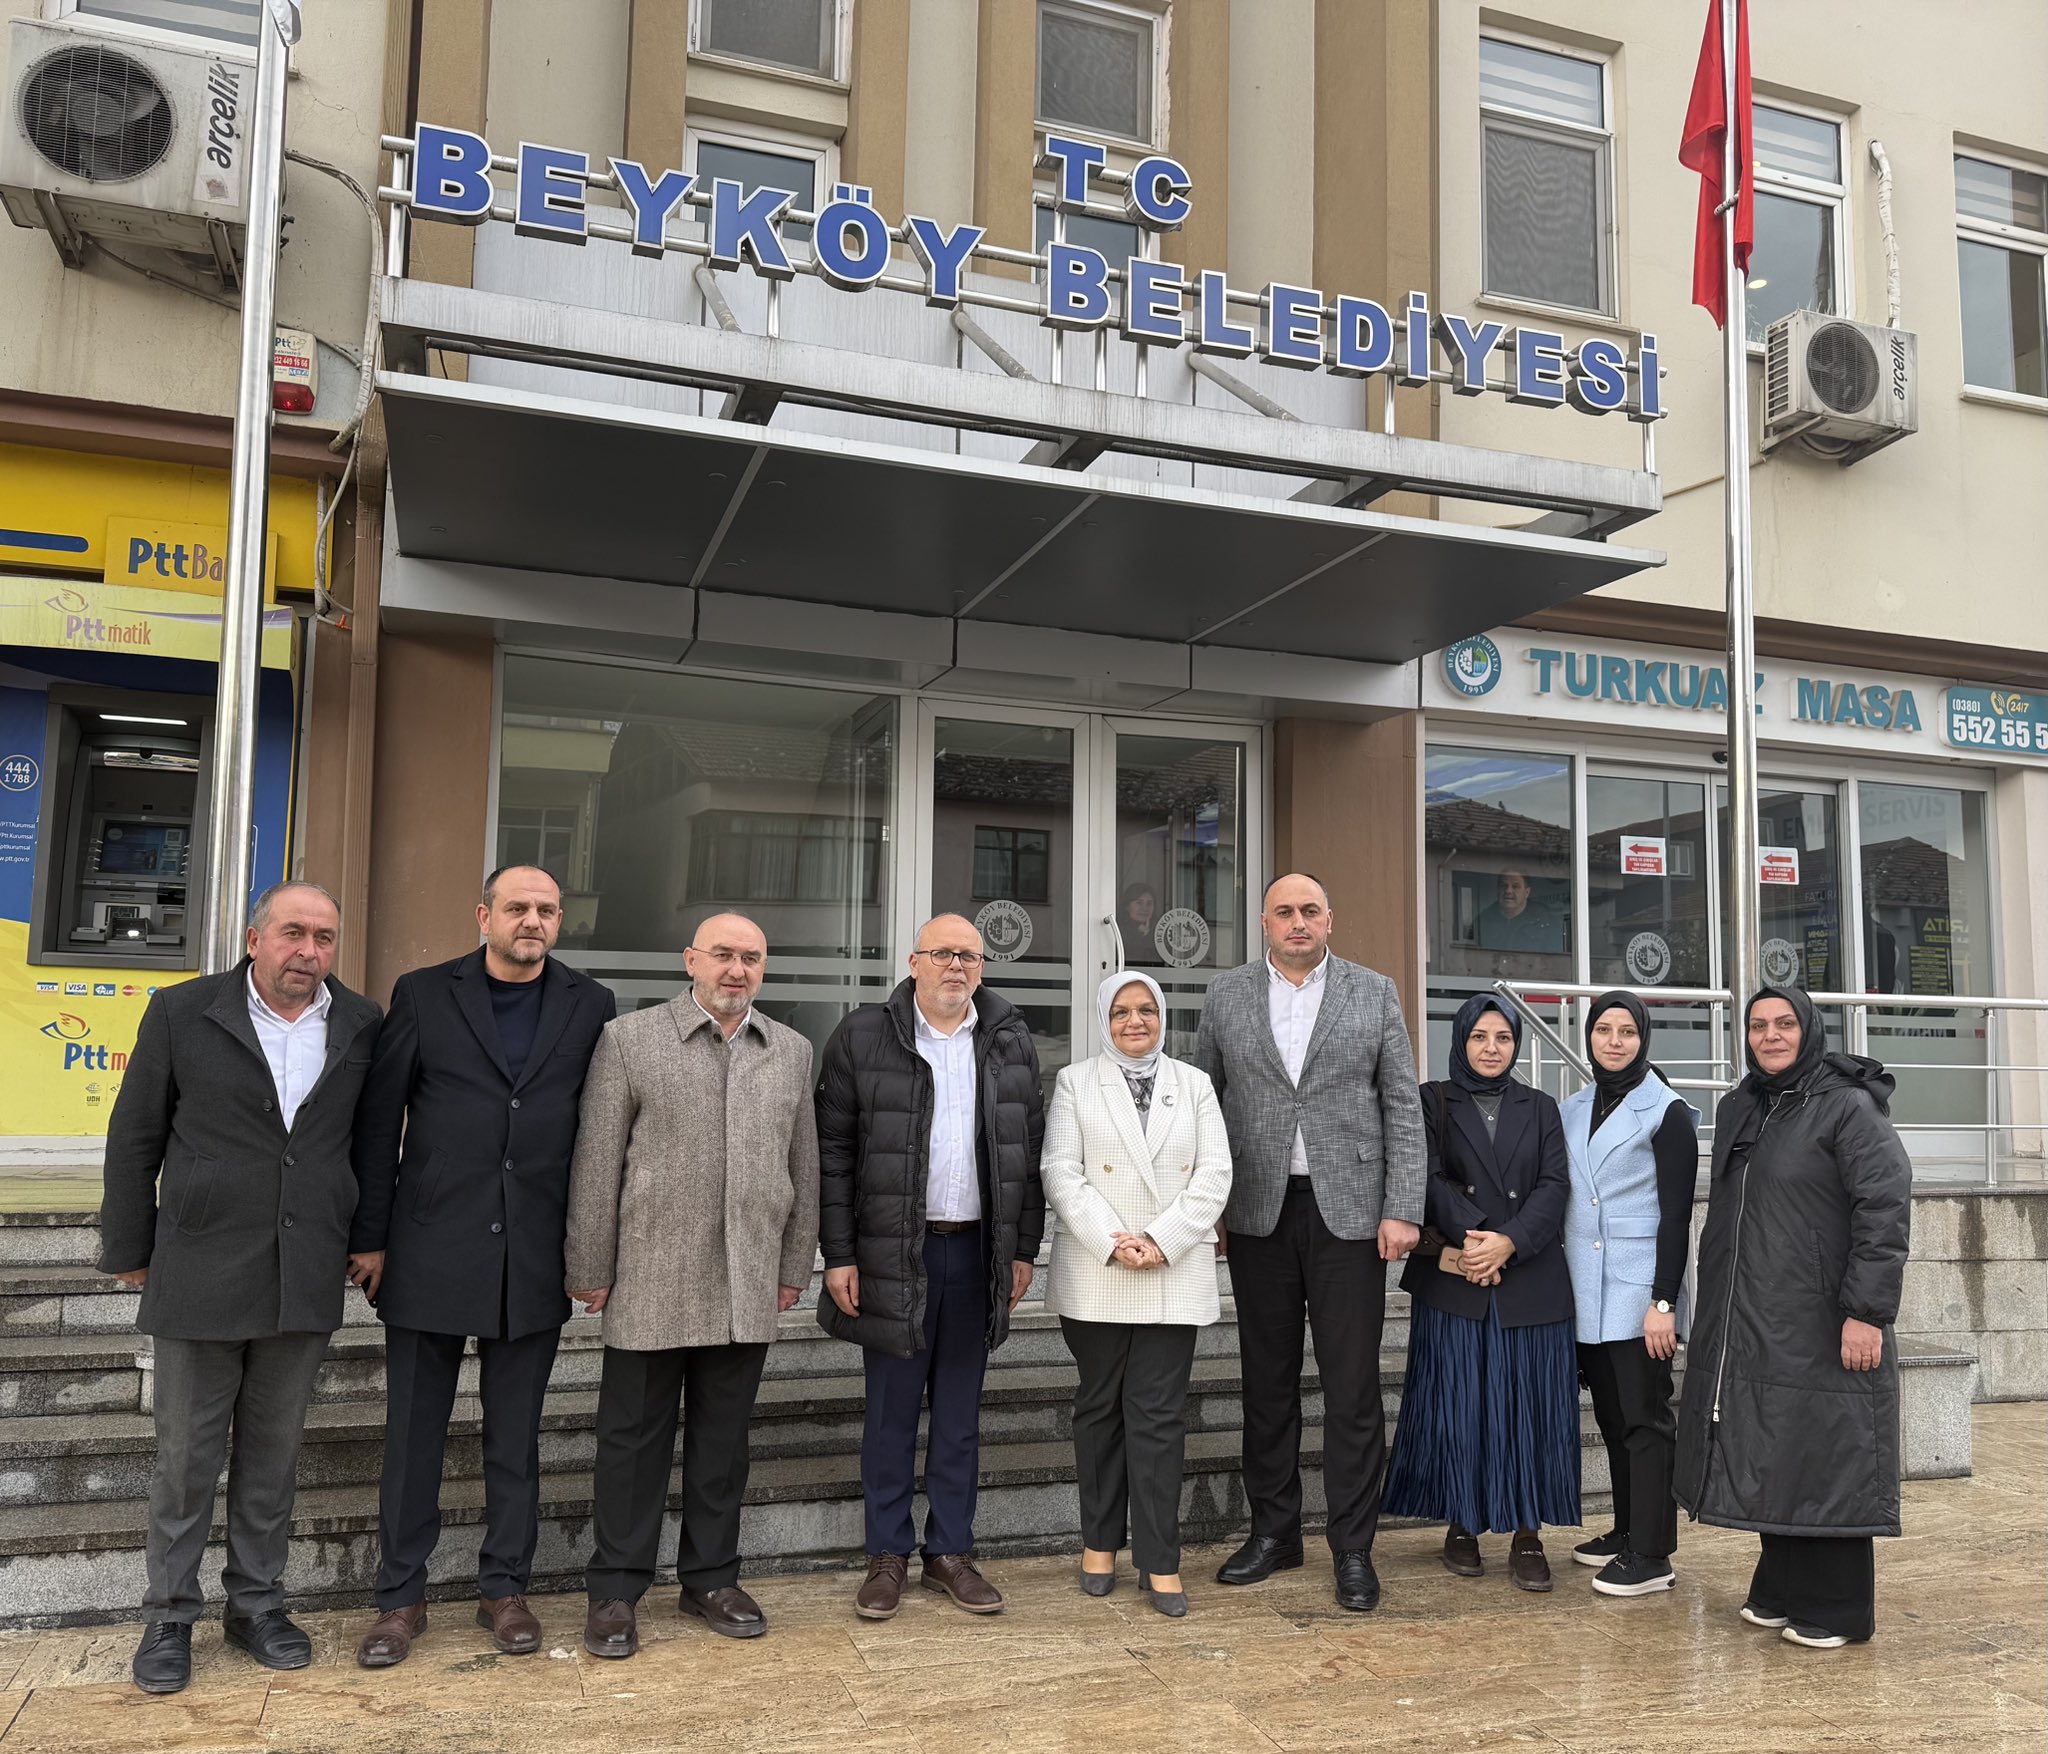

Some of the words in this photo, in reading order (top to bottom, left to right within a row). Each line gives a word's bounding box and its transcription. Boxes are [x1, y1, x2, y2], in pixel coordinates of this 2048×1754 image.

[206, 63, 241, 169] arçelik
[410, 121, 987, 309] BEYKÖY
[1040, 239, 1667, 424] BELEDİYESİ
[1890, 335, 1908, 401] arçelik
[127, 537, 226, 582] PttBa
[1463, 684, 1484, 694] 1991
[1527, 646, 1765, 716] TURKUA
[1796, 676, 1923, 732] MASA
[1952, 698, 1981, 713] (0380)
[2010, 701, 2030, 713] 24/7
[1952, 713, 1996, 745] 552
[2000, 718, 2031, 748] 55
[5, 761, 30, 774] 444
[68, 983, 87, 991] VISA
[64, 1042, 127, 1071] Pttm
